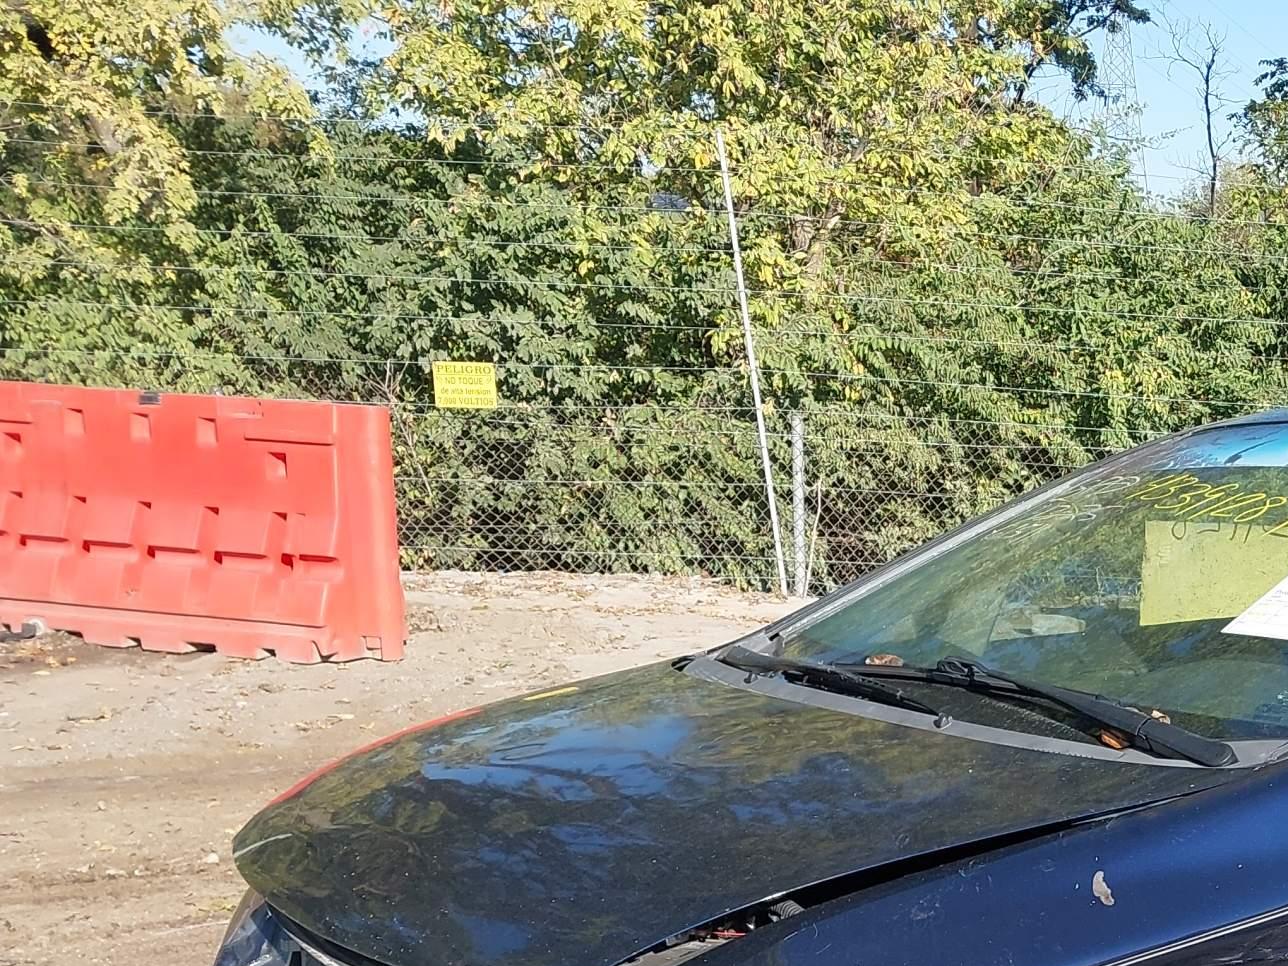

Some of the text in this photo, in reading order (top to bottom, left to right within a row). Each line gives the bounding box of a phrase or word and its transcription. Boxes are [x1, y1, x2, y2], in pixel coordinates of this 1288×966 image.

[436, 364, 492, 375] PELIGRO
[445, 376, 484, 386] NO TOQUE
[458, 396, 494, 406] VOLTIOS
